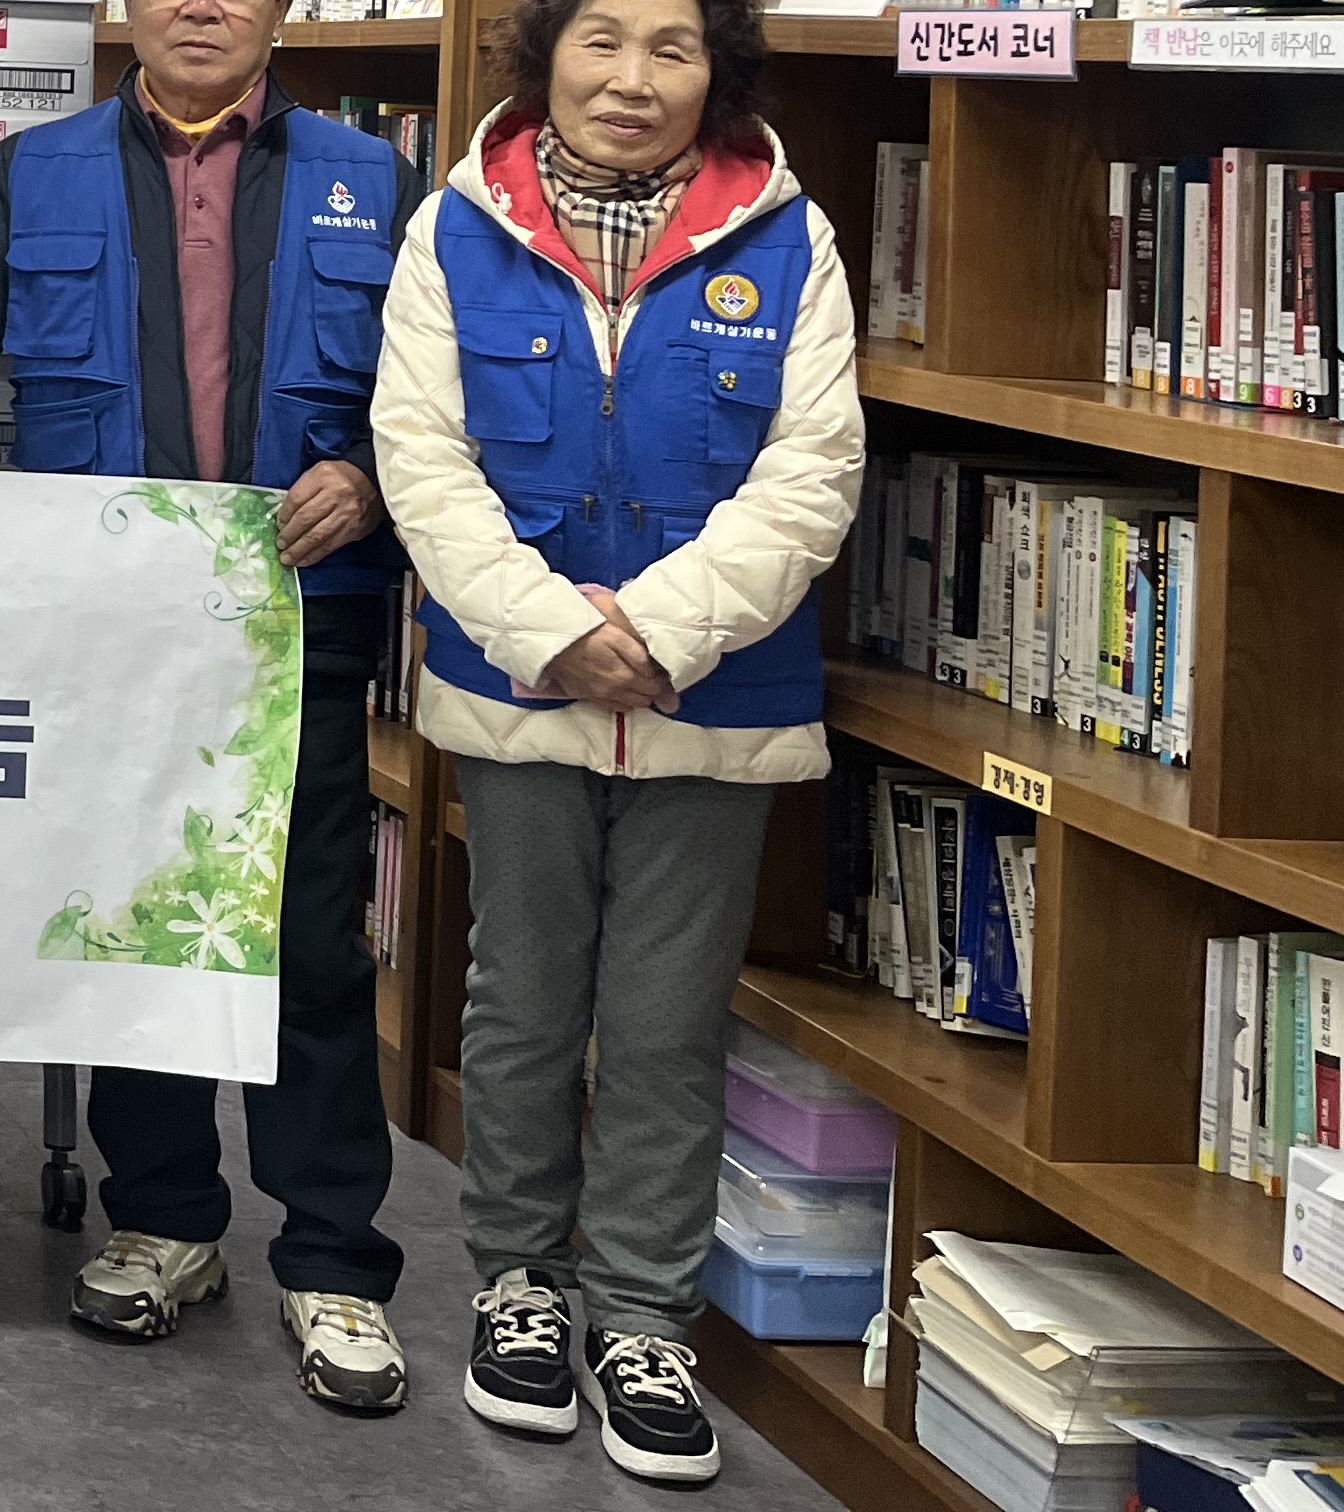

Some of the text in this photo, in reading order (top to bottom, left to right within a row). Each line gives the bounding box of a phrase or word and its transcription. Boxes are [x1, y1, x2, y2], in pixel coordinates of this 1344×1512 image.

[910, 20, 1055, 63] 신간도서 코너
[1143, 27, 1336, 59] 책 반납은 이곳에 해주세요
[690, 318, 777, 340] 바르게살기운동
[1306, 395, 1316, 414] 3
[953, 667, 962, 684] 3
[1032, 697, 1042, 715] 3
[1082, 715, 1093, 734] 3
[1132, 732, 1142, 751] 3
[991, 764, 1045, 806] 경제·경영
